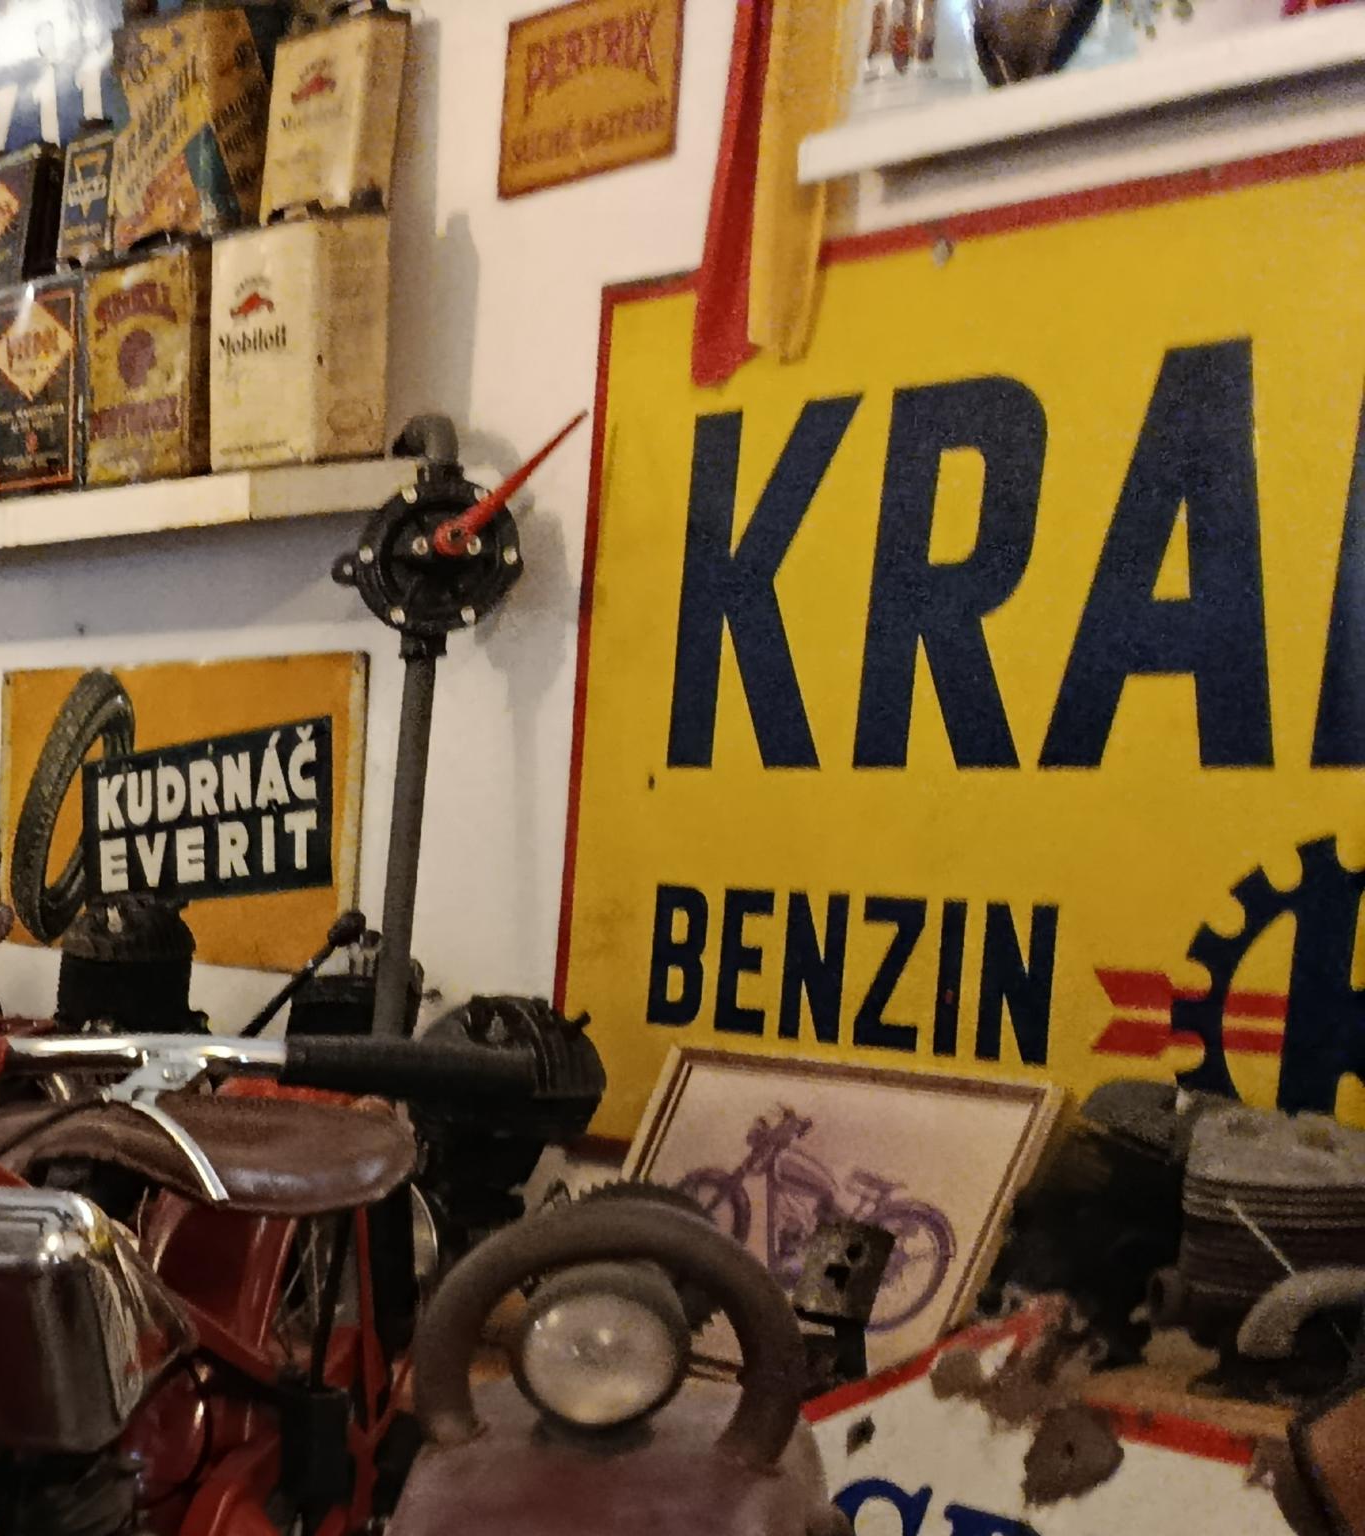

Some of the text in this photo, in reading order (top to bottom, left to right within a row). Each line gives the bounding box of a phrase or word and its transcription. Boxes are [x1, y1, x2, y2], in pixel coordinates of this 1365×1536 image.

[666, 335, 1365, 771] KRA
[97, 726, 318, 833] KUDRNÁČ
[98, 810, 318, 893] EVERIT
[646, 884, 1059, 1066] BENZIN
